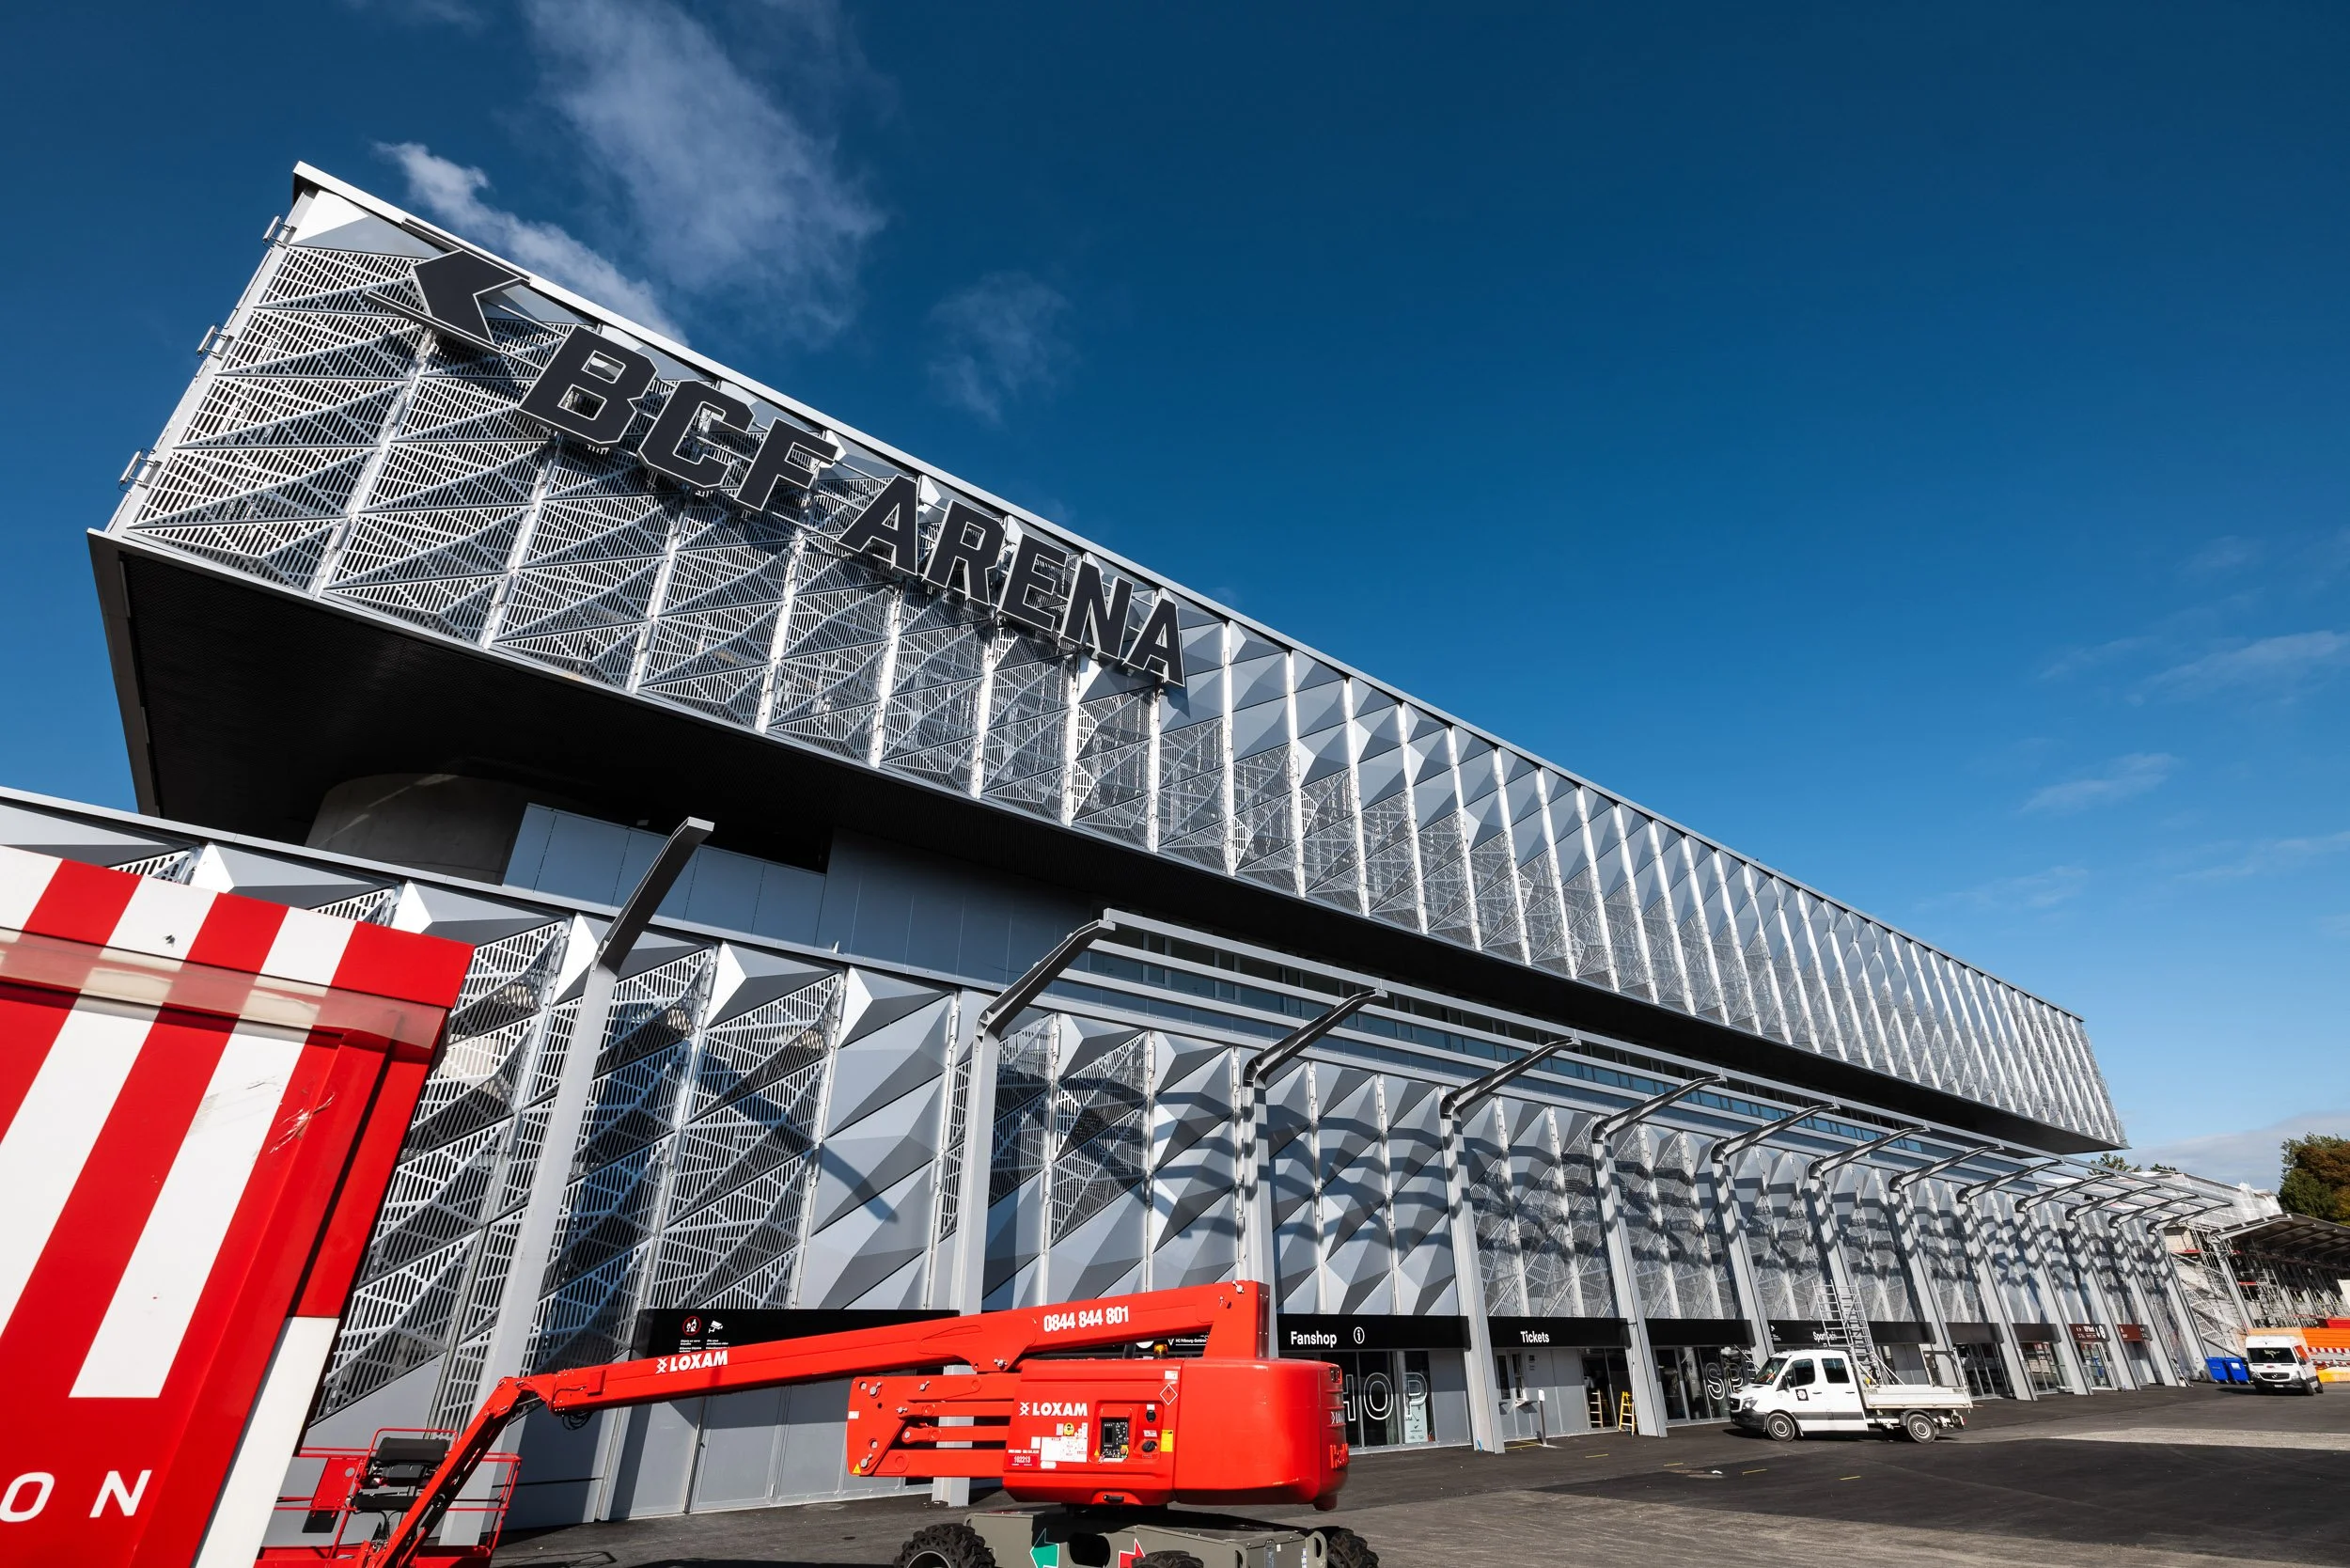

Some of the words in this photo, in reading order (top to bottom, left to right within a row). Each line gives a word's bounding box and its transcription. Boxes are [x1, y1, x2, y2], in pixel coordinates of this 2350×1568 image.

[517, 324, 838, 510] BCF
[837, 474, 1186, 686] ARENA
[1043, 1311, 1075, 1332] 0844
[1078, 1309, 1104, 1328] 844
[1105, 1305, 1129, 1325] 801
[1291, 1330, 1338, 1348] Fanshop
[1520, 1330, 1550, 1343] Tickets
[669, 1350, 728, 1372] LOXAM
[1343, 1372, 1428, 1421] HOP
[1032, 1402, 1088, 1417] LOXAM
